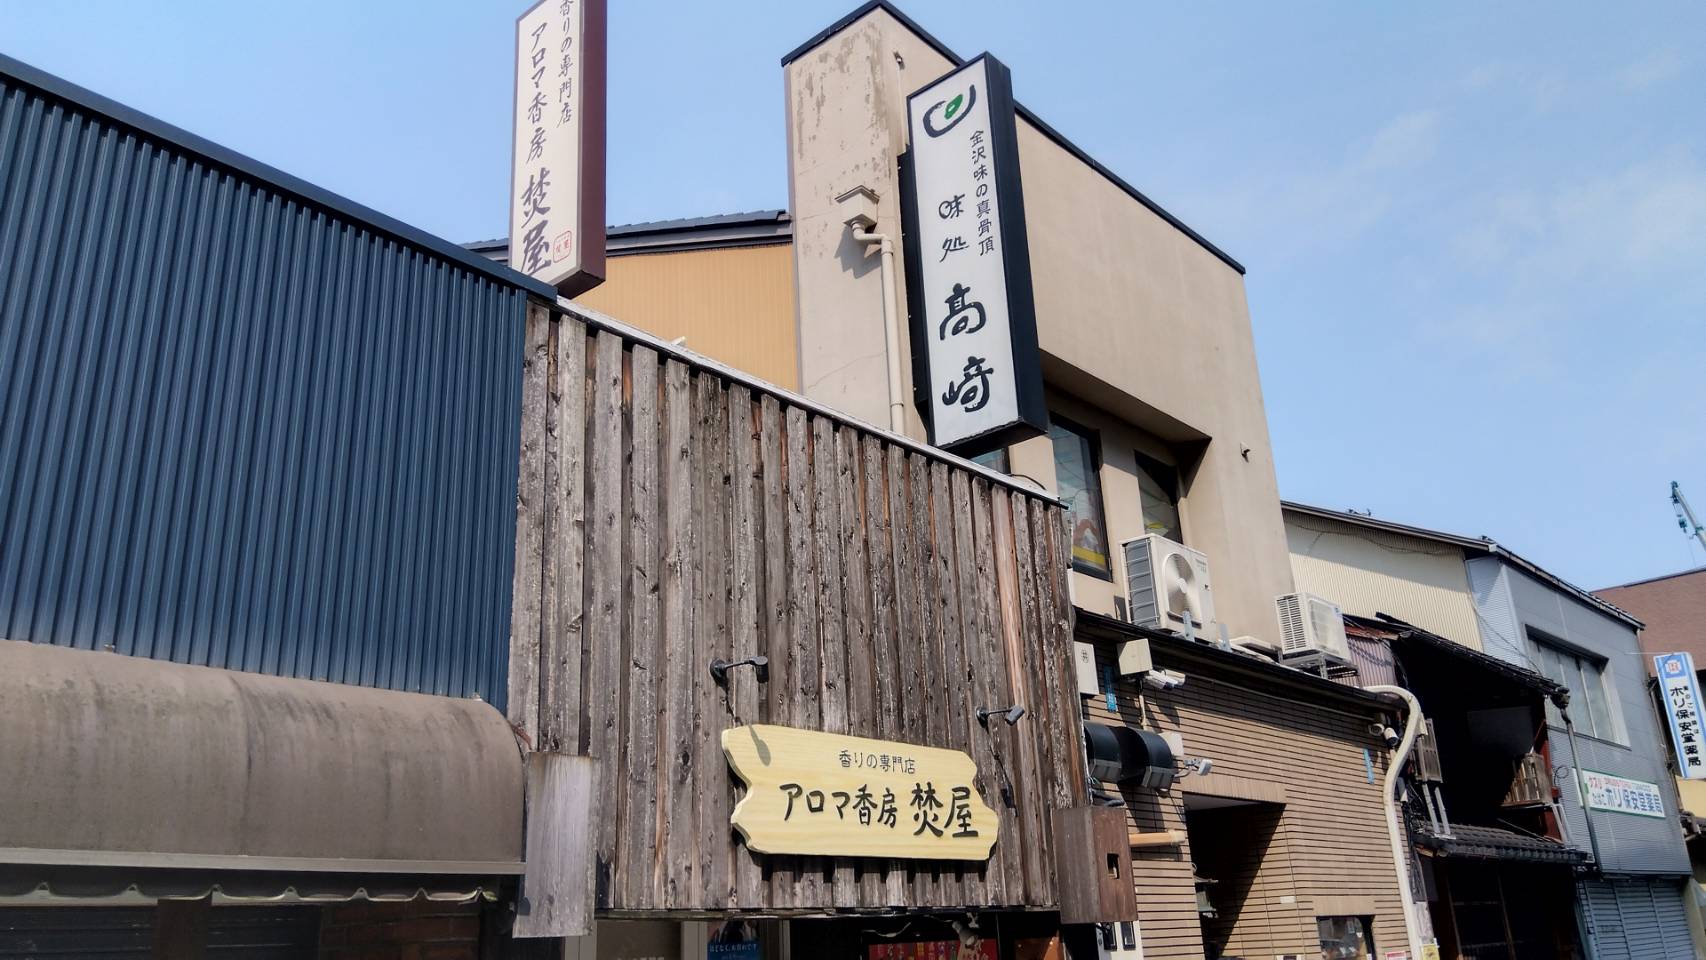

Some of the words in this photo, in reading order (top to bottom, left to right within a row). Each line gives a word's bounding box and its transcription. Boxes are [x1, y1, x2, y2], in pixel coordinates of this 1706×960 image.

[970, 130, 995, 256] 金沢味の真骨頂
[839, 749, 916, 775] 香りの専門店
[1670, 687, 1701, 767] ホリ保安堂薬局
